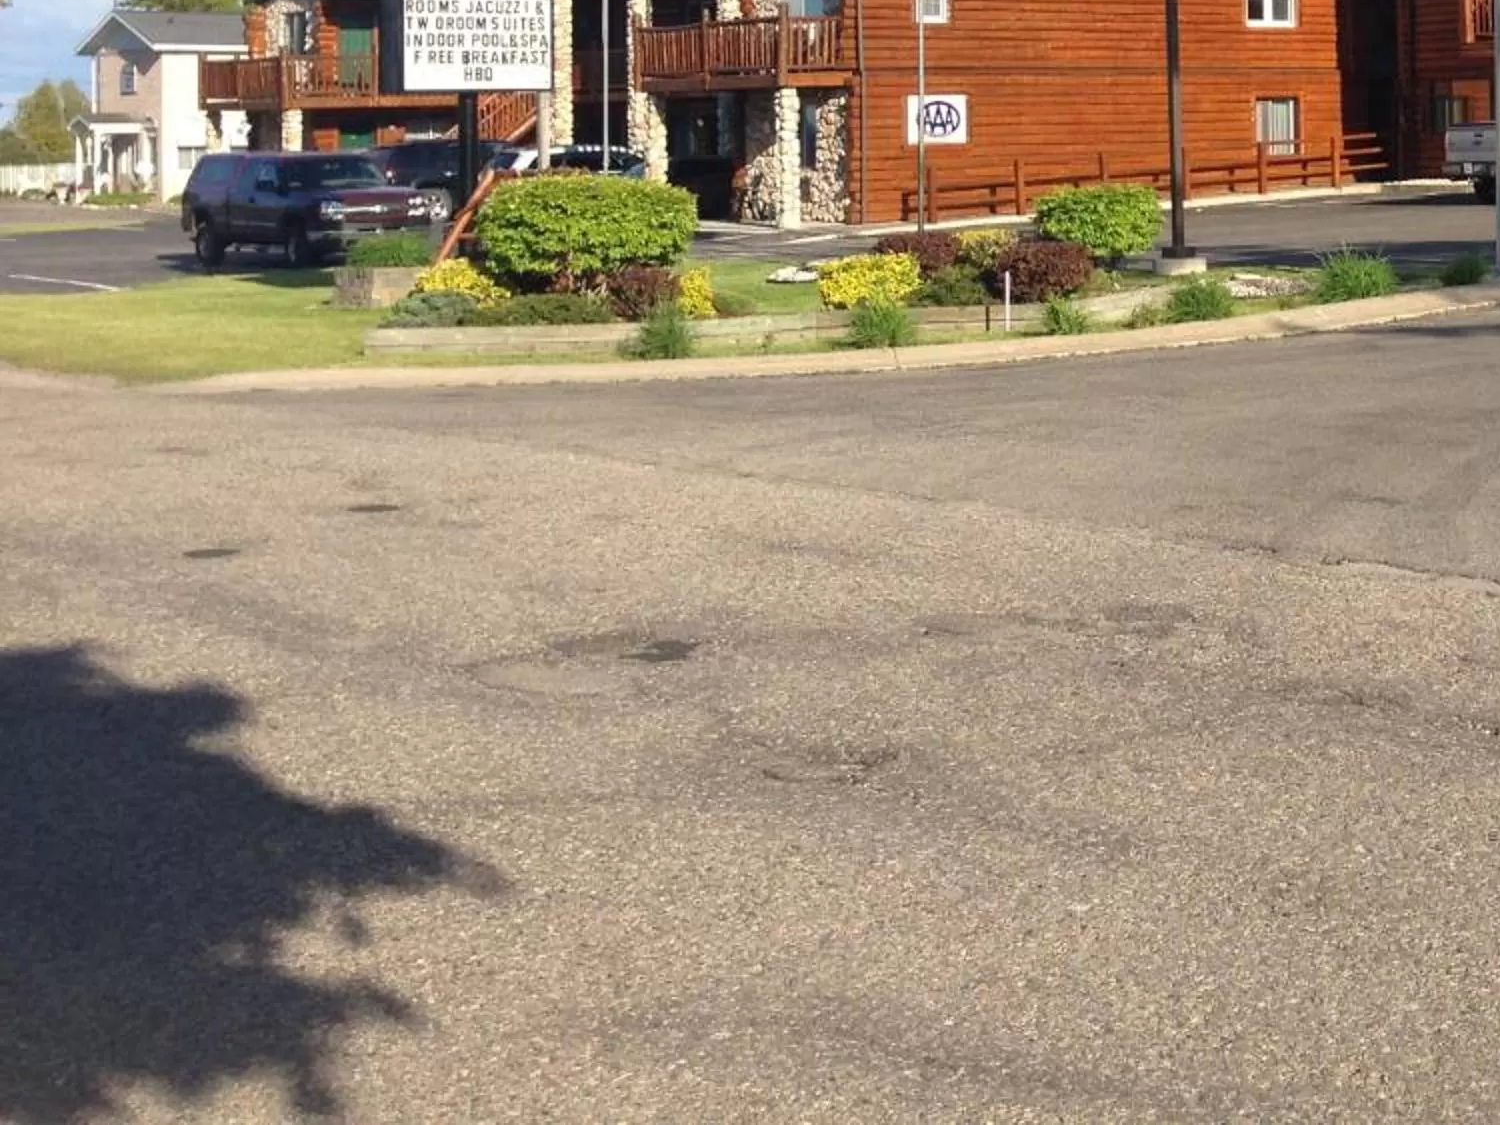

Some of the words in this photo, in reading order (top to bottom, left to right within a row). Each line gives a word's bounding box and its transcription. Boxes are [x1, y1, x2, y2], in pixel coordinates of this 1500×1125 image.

[406, 0, 459, 14] ROOMS
[491, 17, 545, 31] SUITES
[414, 50, 454, 64] FREE
[461, 50, 548, 65] BREAKFAST
[464, 67, 493, 82] HBO
[920, 103, 957, 135] AAA
